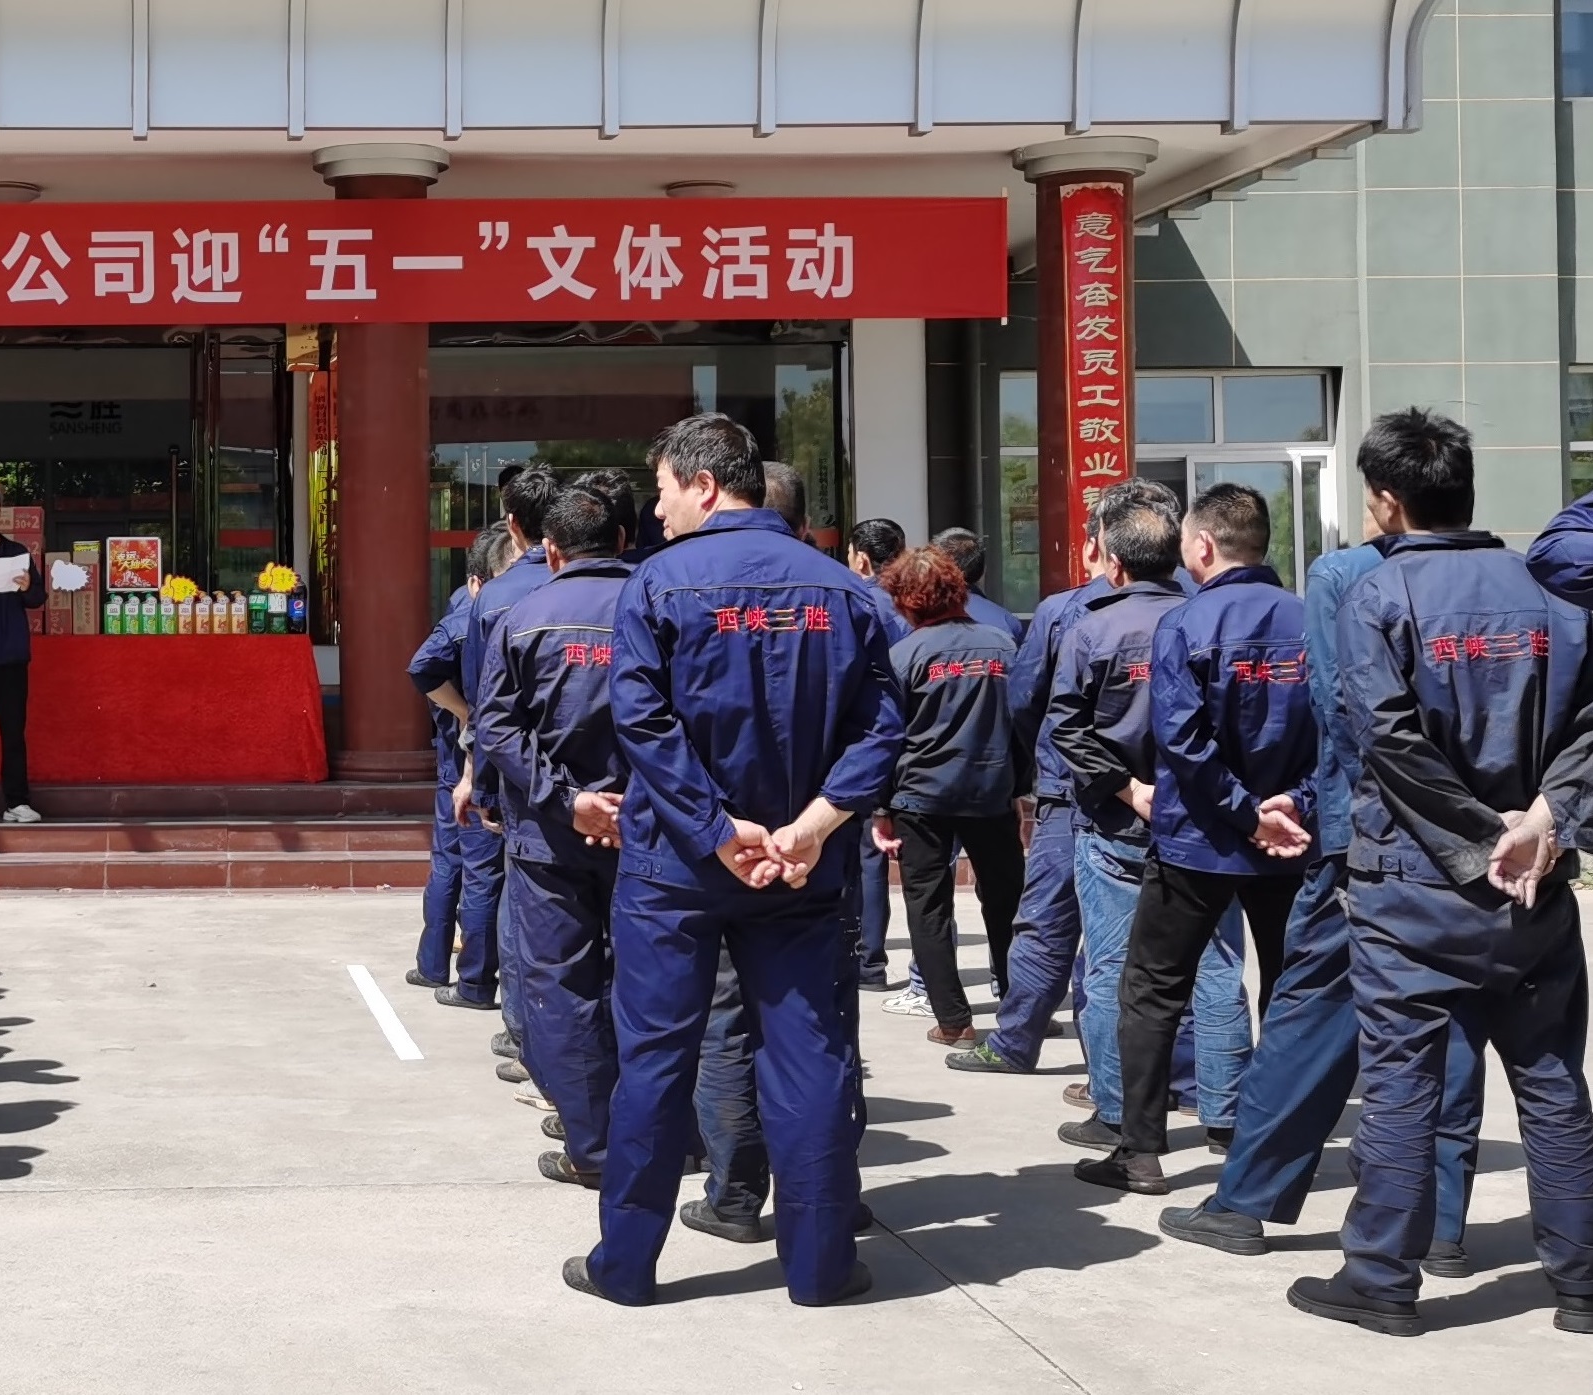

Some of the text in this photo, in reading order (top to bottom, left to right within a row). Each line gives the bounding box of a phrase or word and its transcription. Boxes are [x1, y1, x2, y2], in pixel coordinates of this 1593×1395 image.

[49, 421, 122, 434] SANSHENG
[15, 515, 40, 529] 30+2
[713, 605, 832, 633] 西峡三胜
[928, 658, 1008, 683] 西峡三胜
